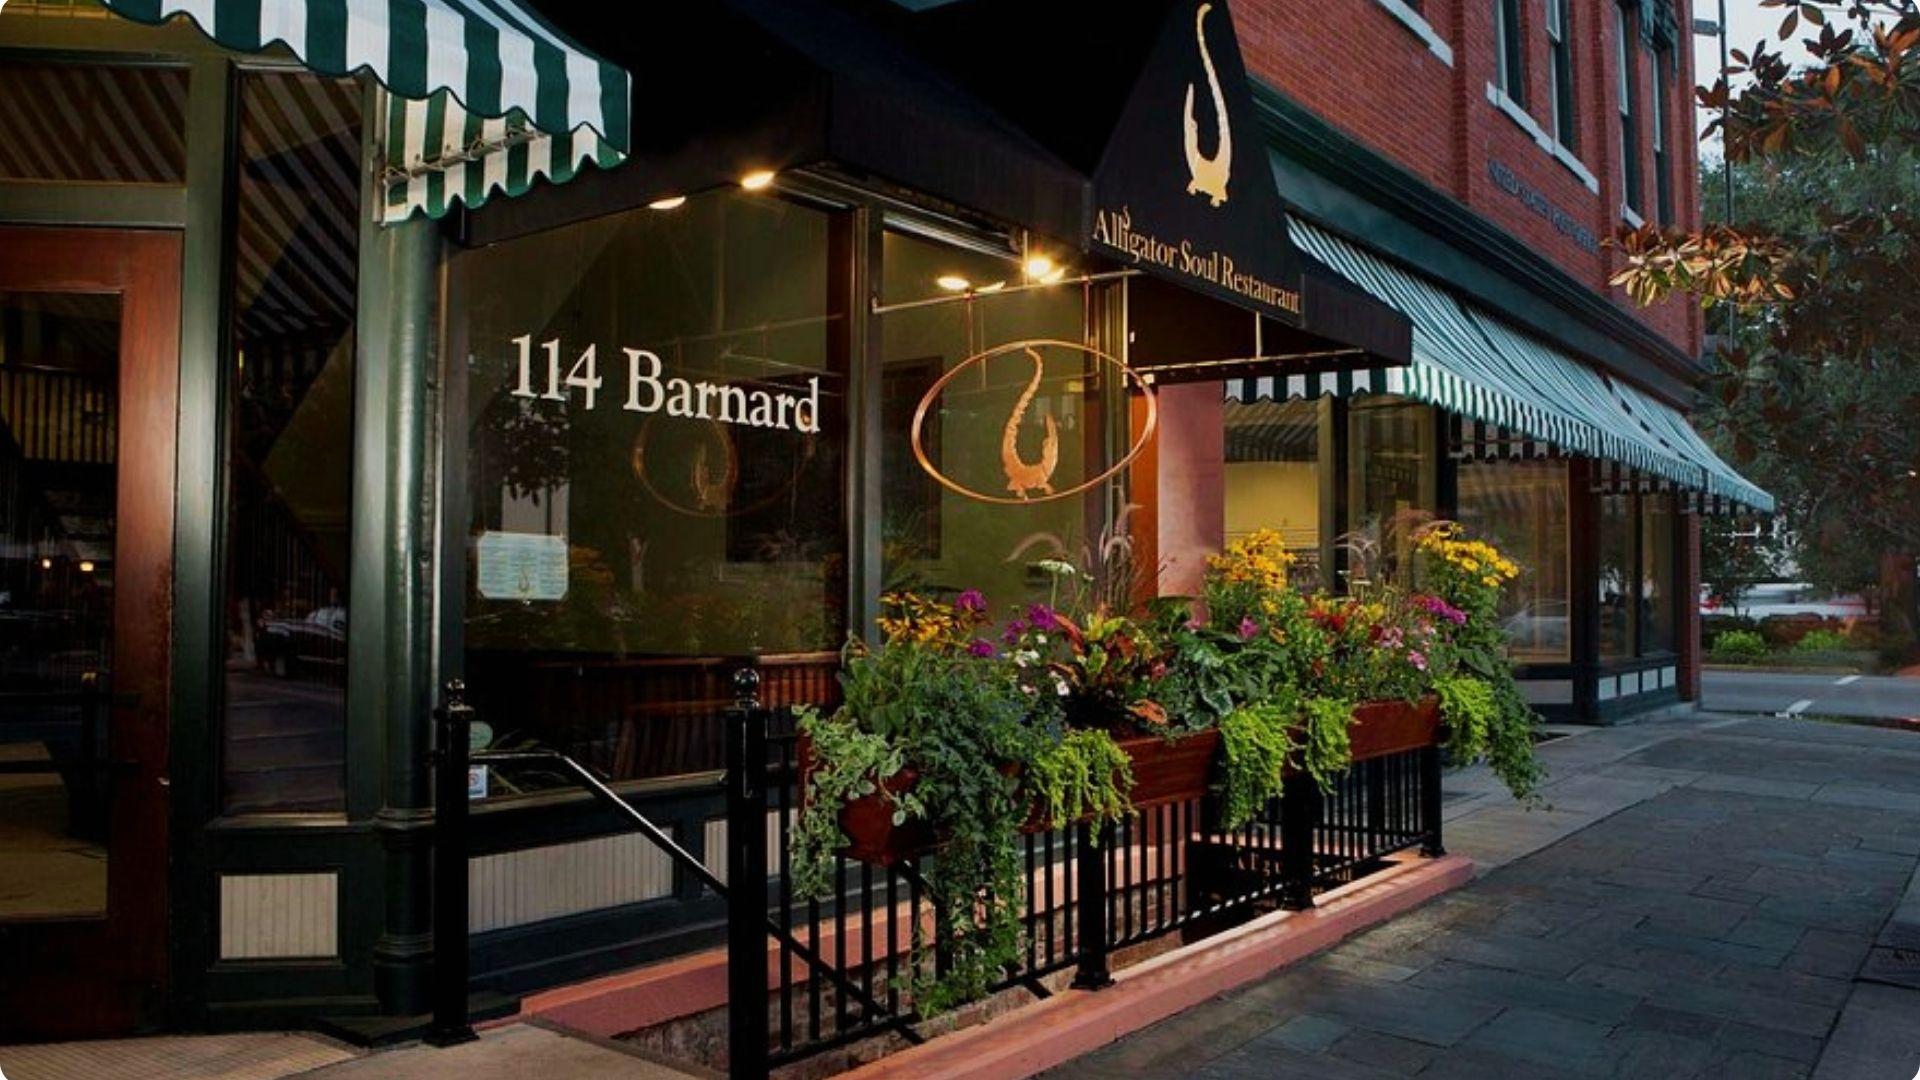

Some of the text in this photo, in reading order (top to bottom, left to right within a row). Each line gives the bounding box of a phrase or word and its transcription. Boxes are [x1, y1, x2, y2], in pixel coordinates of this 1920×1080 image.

[1093, 206, 1301, 314] Alligator Soul Restaurant
[510, 334, 820, 433] 114 Barnard
